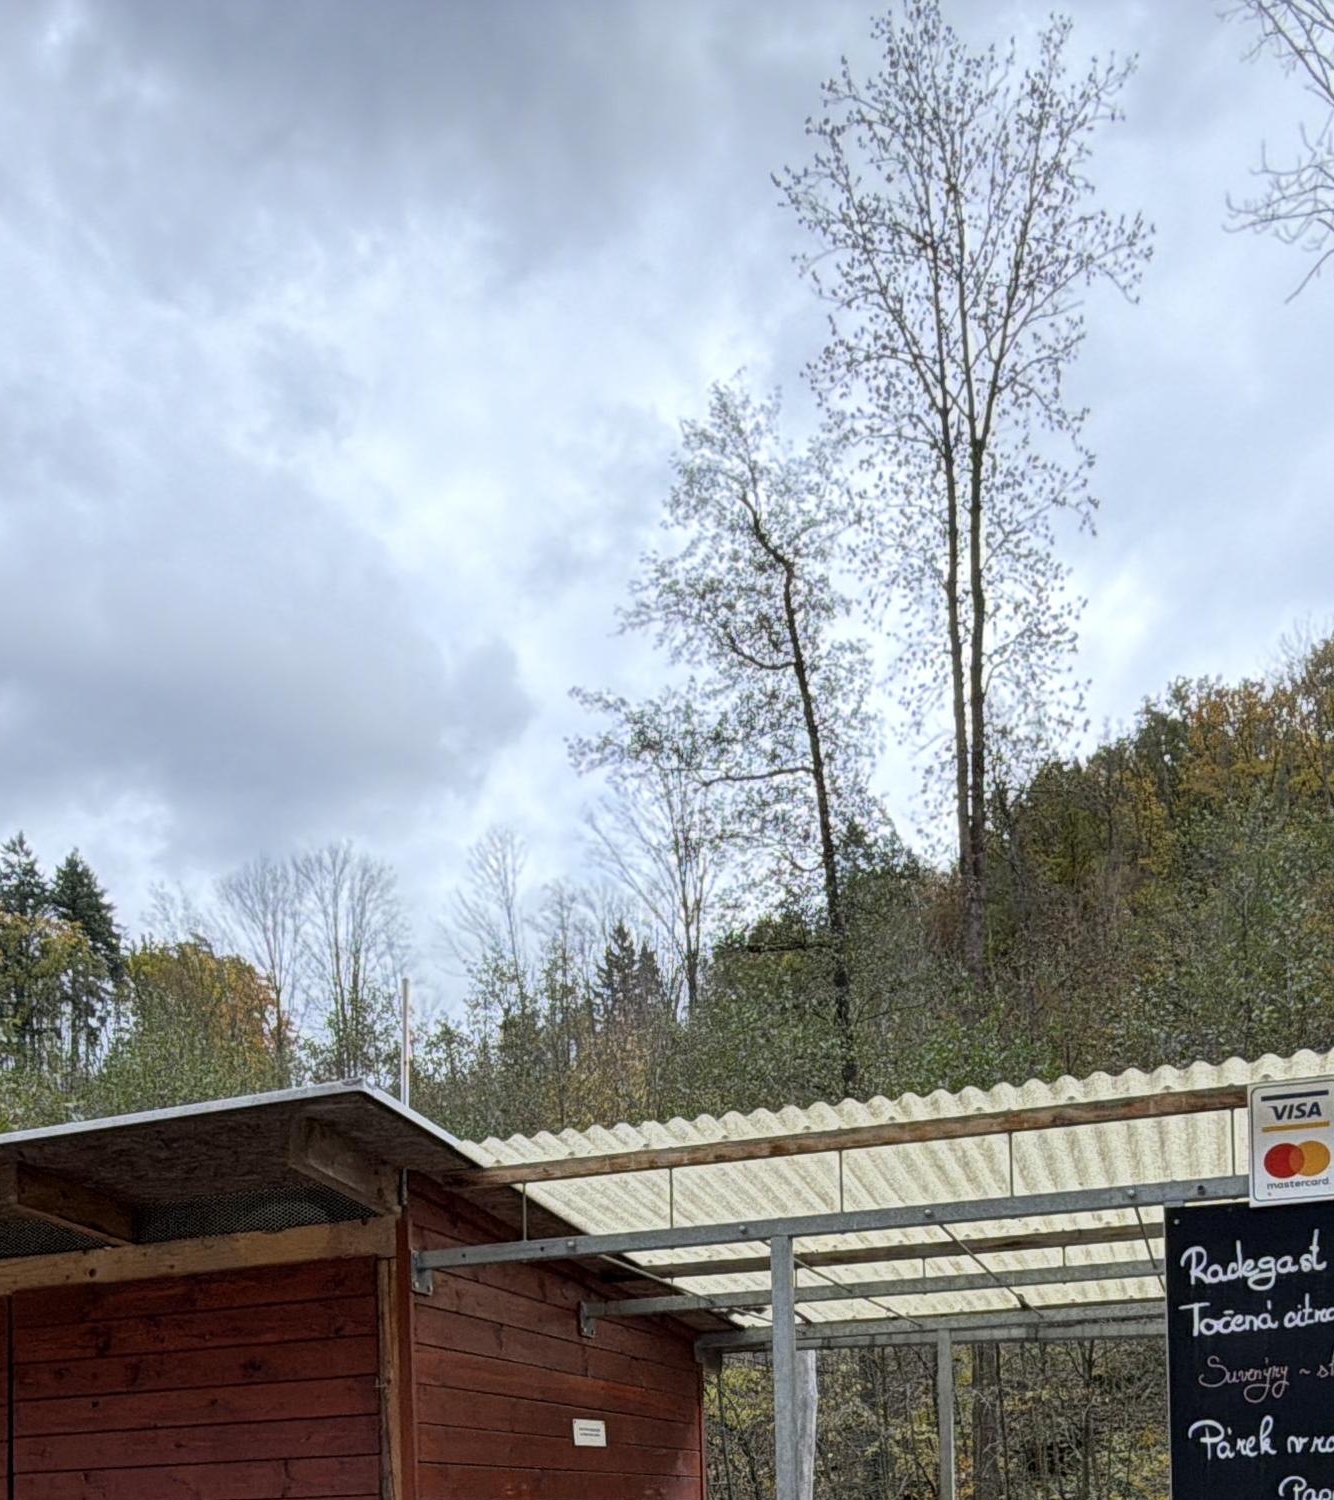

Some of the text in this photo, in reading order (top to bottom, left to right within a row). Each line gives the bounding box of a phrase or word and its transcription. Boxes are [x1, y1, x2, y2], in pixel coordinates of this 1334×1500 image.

[1271, 1101, 1322, 1121] VISA
[1266, 1177, 1330, 1190] mastercard
[1179, 1229, 1327, 1291] Radegast
[1178, 1300, 1278, 1337] Točená
[1198, 1355, 1290, 1402] Suvenýry
[1187, 1414, 1277, 1461] Párek
